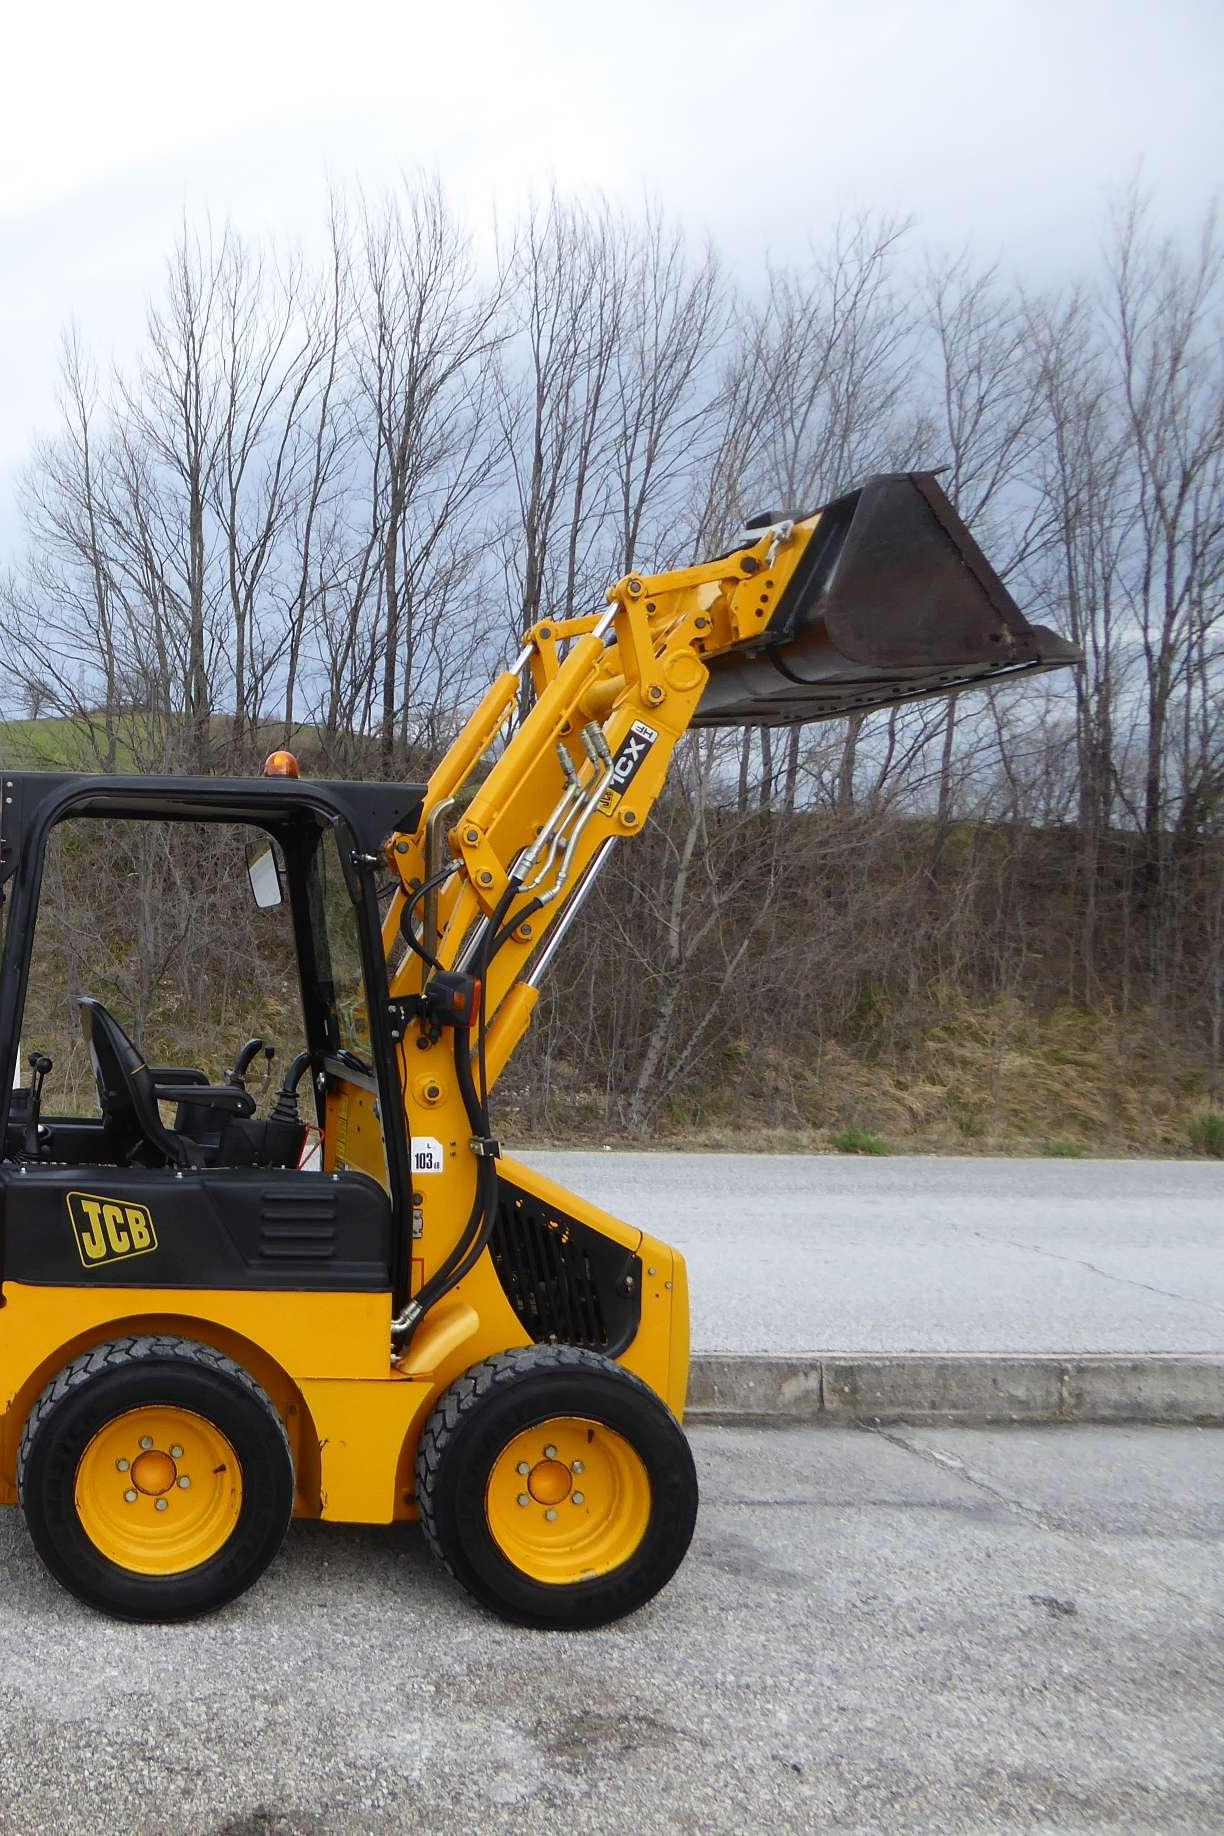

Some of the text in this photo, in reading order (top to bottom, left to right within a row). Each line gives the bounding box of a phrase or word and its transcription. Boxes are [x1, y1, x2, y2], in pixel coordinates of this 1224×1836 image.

[635, 724, 654, 739] HF
[414, 1152, 433, 1169] 103
[81, 1199, 151, 1259] JCB
